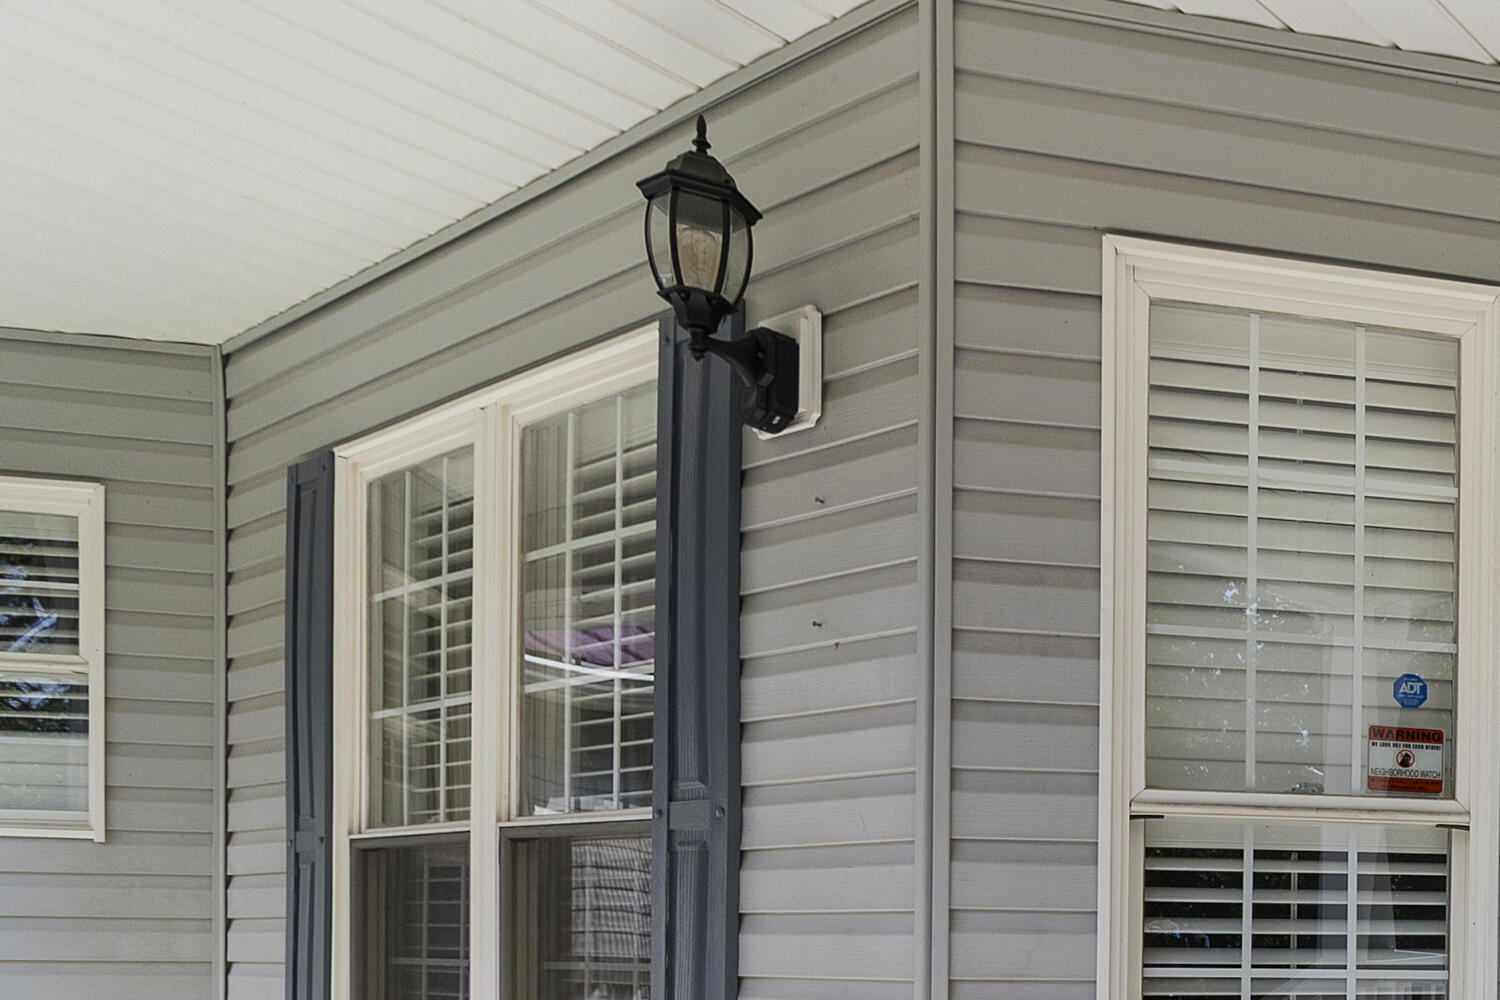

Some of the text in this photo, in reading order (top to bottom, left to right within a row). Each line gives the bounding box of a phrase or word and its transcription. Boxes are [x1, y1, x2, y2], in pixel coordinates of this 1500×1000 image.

[1399, 682, 1424, 694] ADT
[1372, 728, 1441, 742] WARNING
[1370, 767, 1441, 779] NEIGHBORHOOD WATCH
